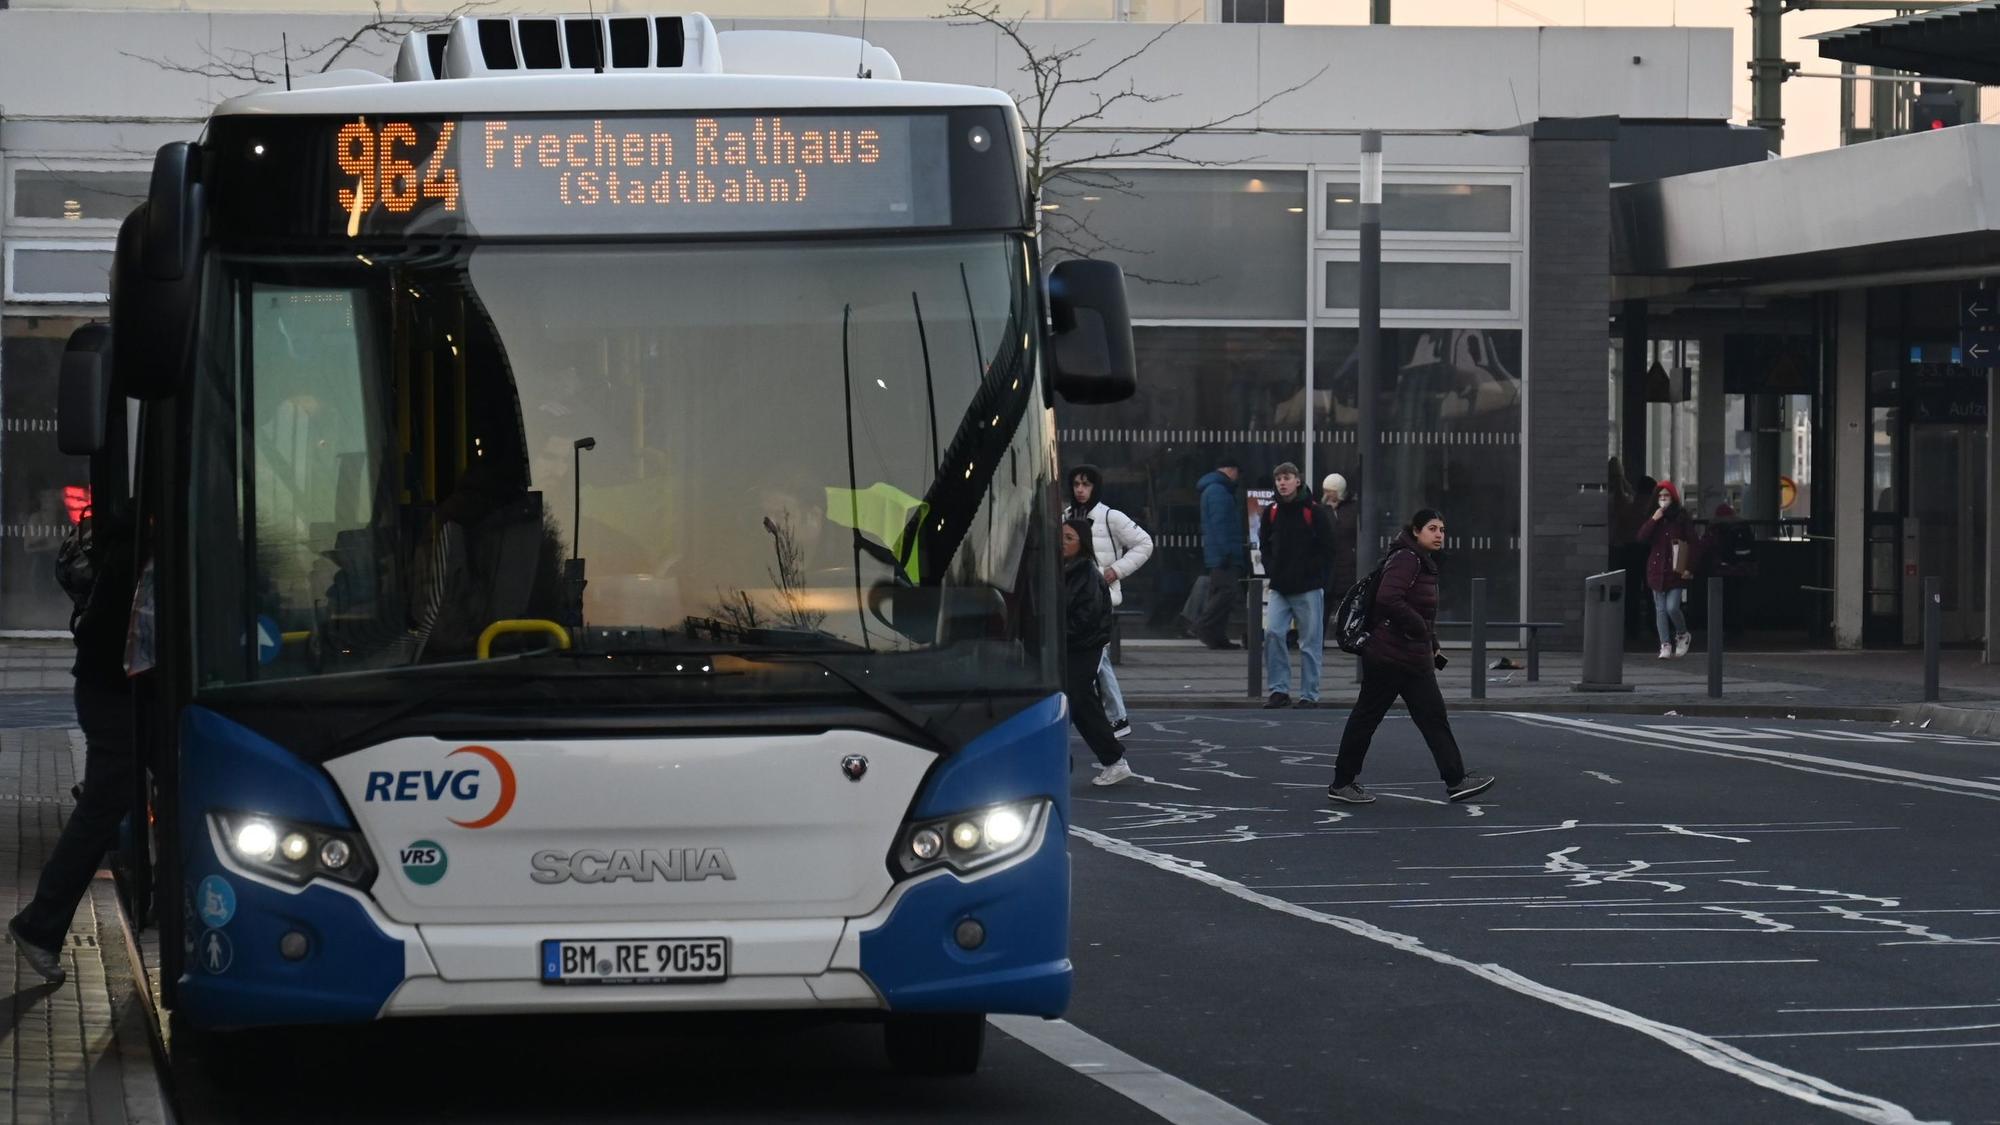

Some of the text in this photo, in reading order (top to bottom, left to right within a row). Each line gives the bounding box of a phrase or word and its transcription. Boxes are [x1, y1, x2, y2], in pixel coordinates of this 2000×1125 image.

[485, 118, 880, 168] Frechen Rathaus
[337, 121, 460, 213] 964
[560, 169, 808, 205] (Stadtbahn)
[1247, 490, 1275, 498] FRIED
[365, 769, 480, 802] REVG
[400, 849, 436, 865] VRS
[530, 848, 737, 885] SCANIA
[562, 943, 722, 974] BM RE 9055
